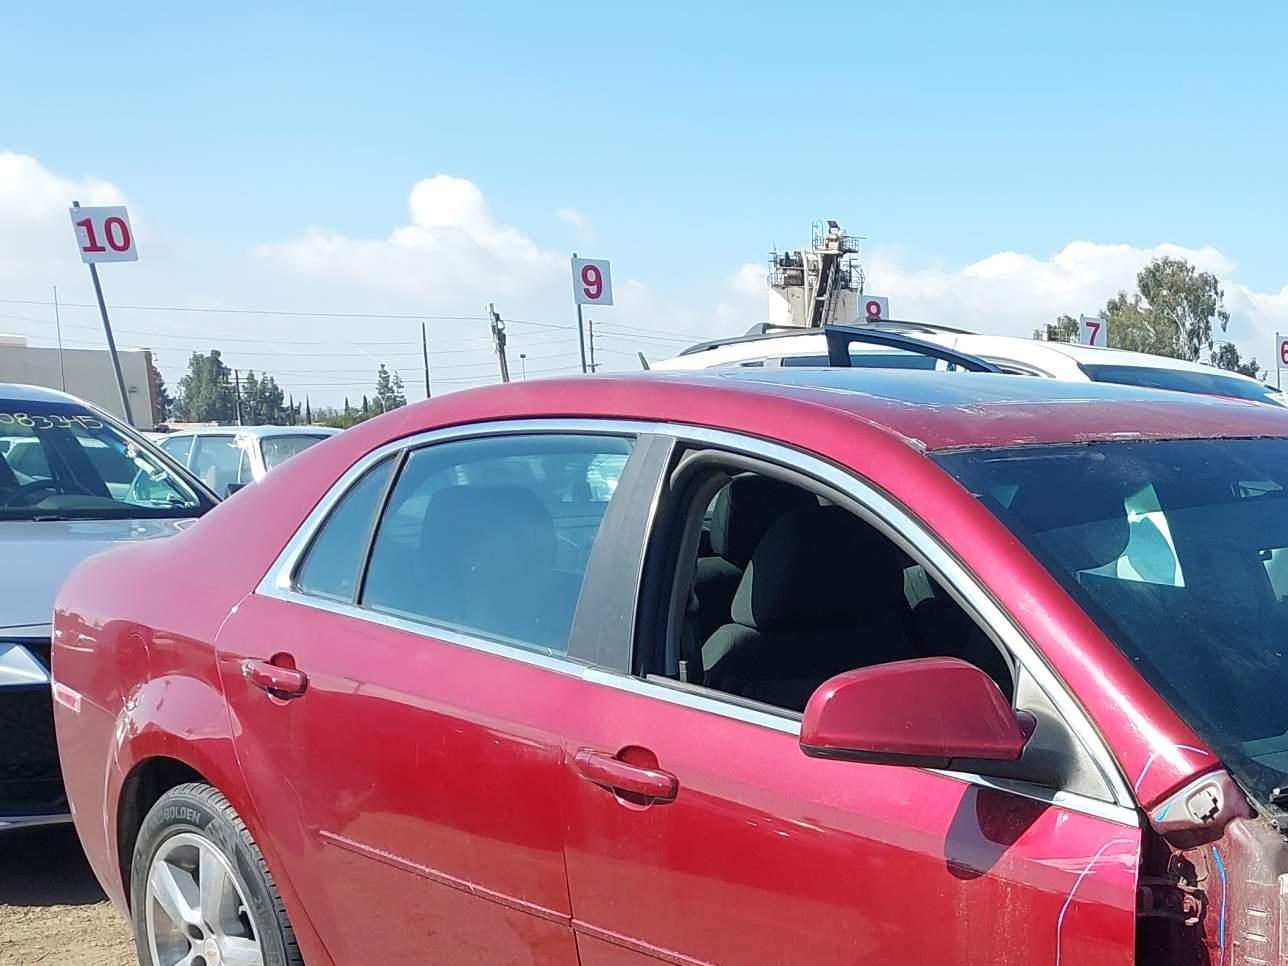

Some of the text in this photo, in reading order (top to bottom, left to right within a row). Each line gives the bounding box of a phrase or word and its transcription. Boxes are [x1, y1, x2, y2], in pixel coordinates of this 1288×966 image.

[76, 216, 130, 252] 10
[581, 264, 603, 299] 9
[1085, 321, 1100, 346] 7
